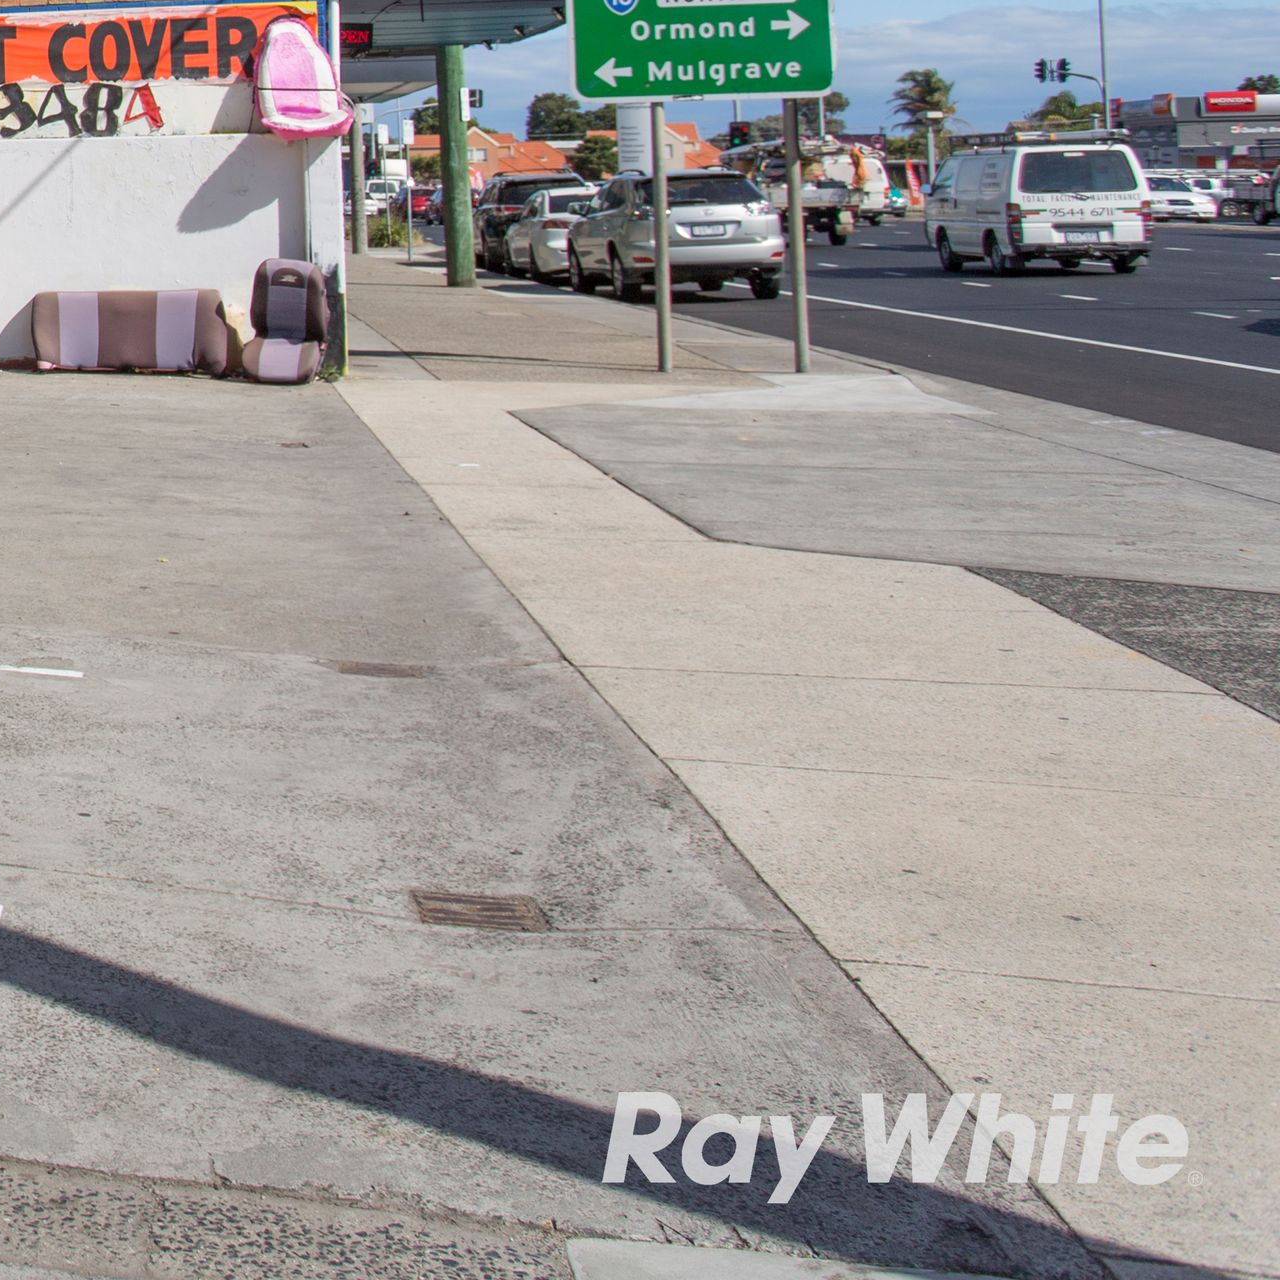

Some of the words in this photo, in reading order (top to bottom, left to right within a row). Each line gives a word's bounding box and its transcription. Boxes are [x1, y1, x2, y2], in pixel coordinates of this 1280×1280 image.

[630, 16, 756, 42] Ormond
[340, 30, 370, 44] PEN
[47, 11, 302, 84] COVER
[647, 59, 802, 87] Mulgrave
[1209, 96, 1254, 105] HONDA
[1022, 194, 1045, 203] TOTAL
[1090, 192, 1142, 201] MAINTENANCE
[1048, 207, 1085, 218] 9544
[1089, 207, 1114, 217] 6711
